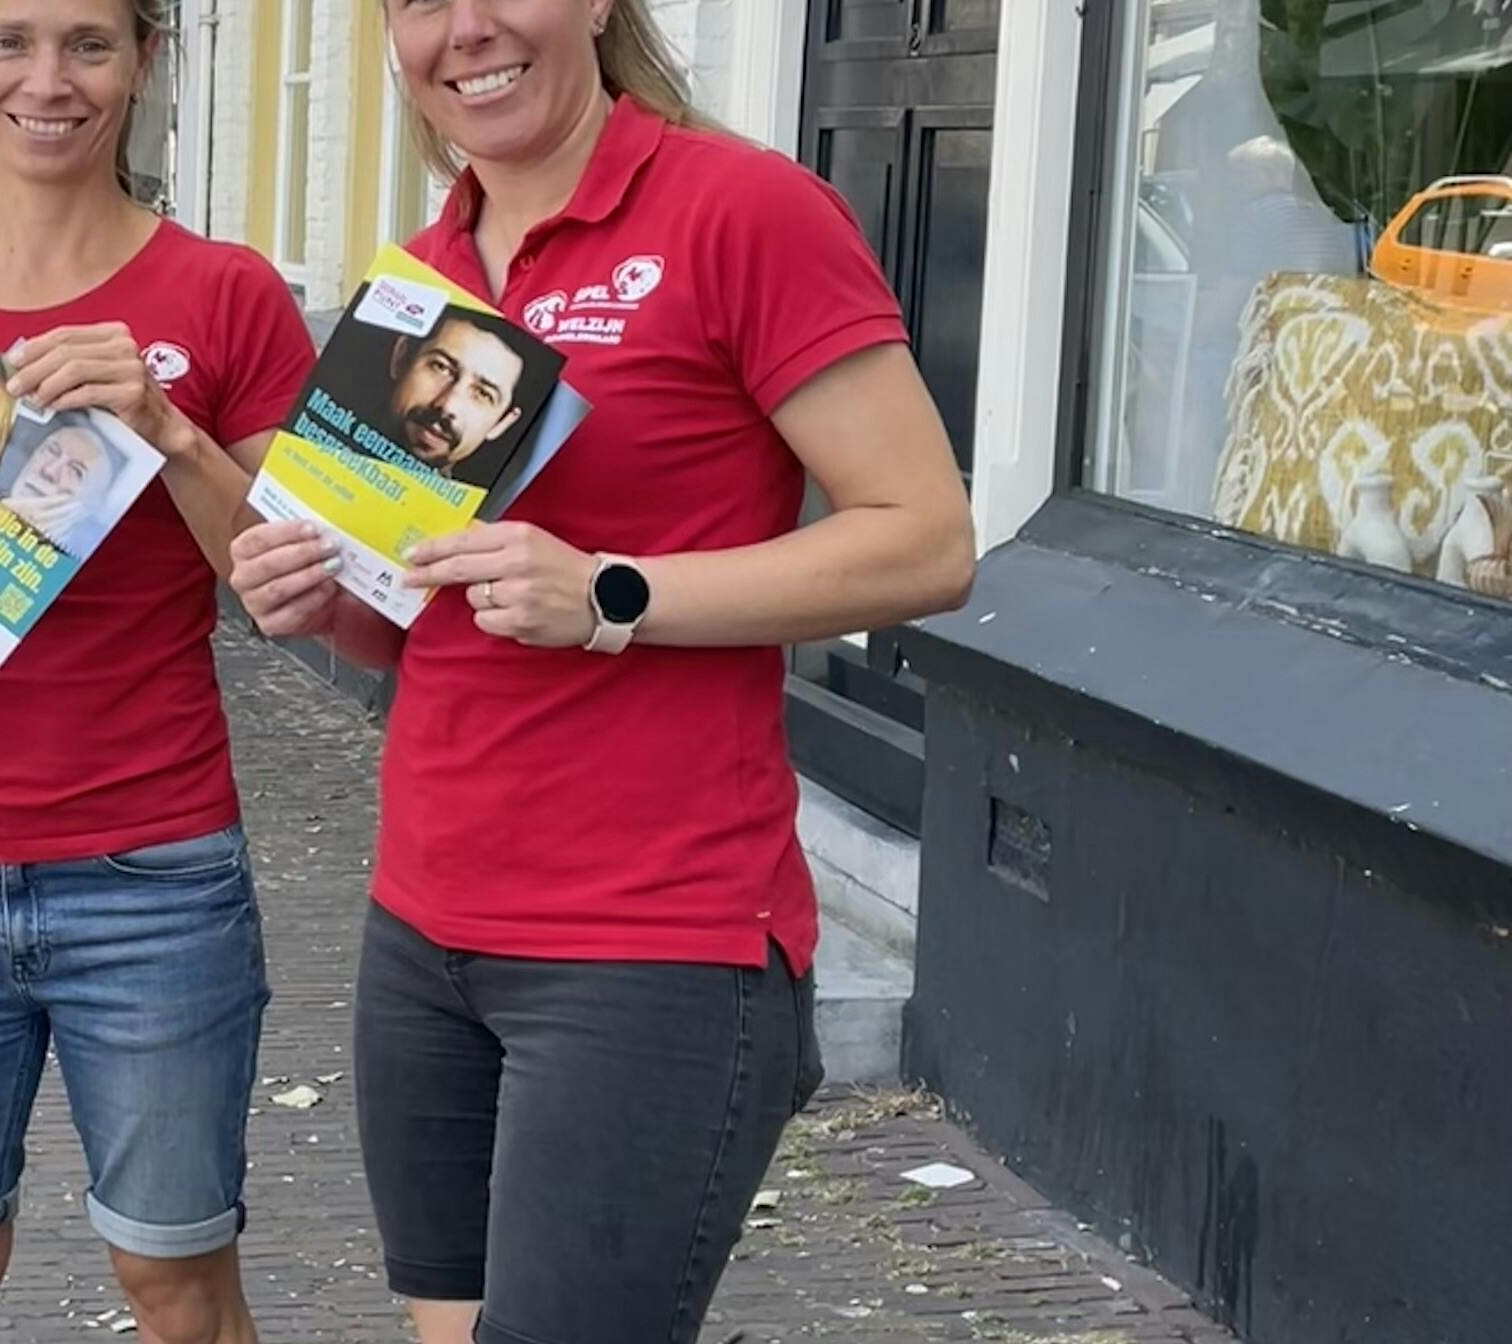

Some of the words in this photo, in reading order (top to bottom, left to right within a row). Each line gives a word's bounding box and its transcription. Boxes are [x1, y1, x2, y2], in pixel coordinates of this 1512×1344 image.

[557, 316, 626, 334] WELZIJN
[294, 412, 408, 506] bespreekbaar.
[307, 387, 356, 435] Maak
[353, 423, 468, 508] eenzaamheid
[34, 544, 58, 569] de
